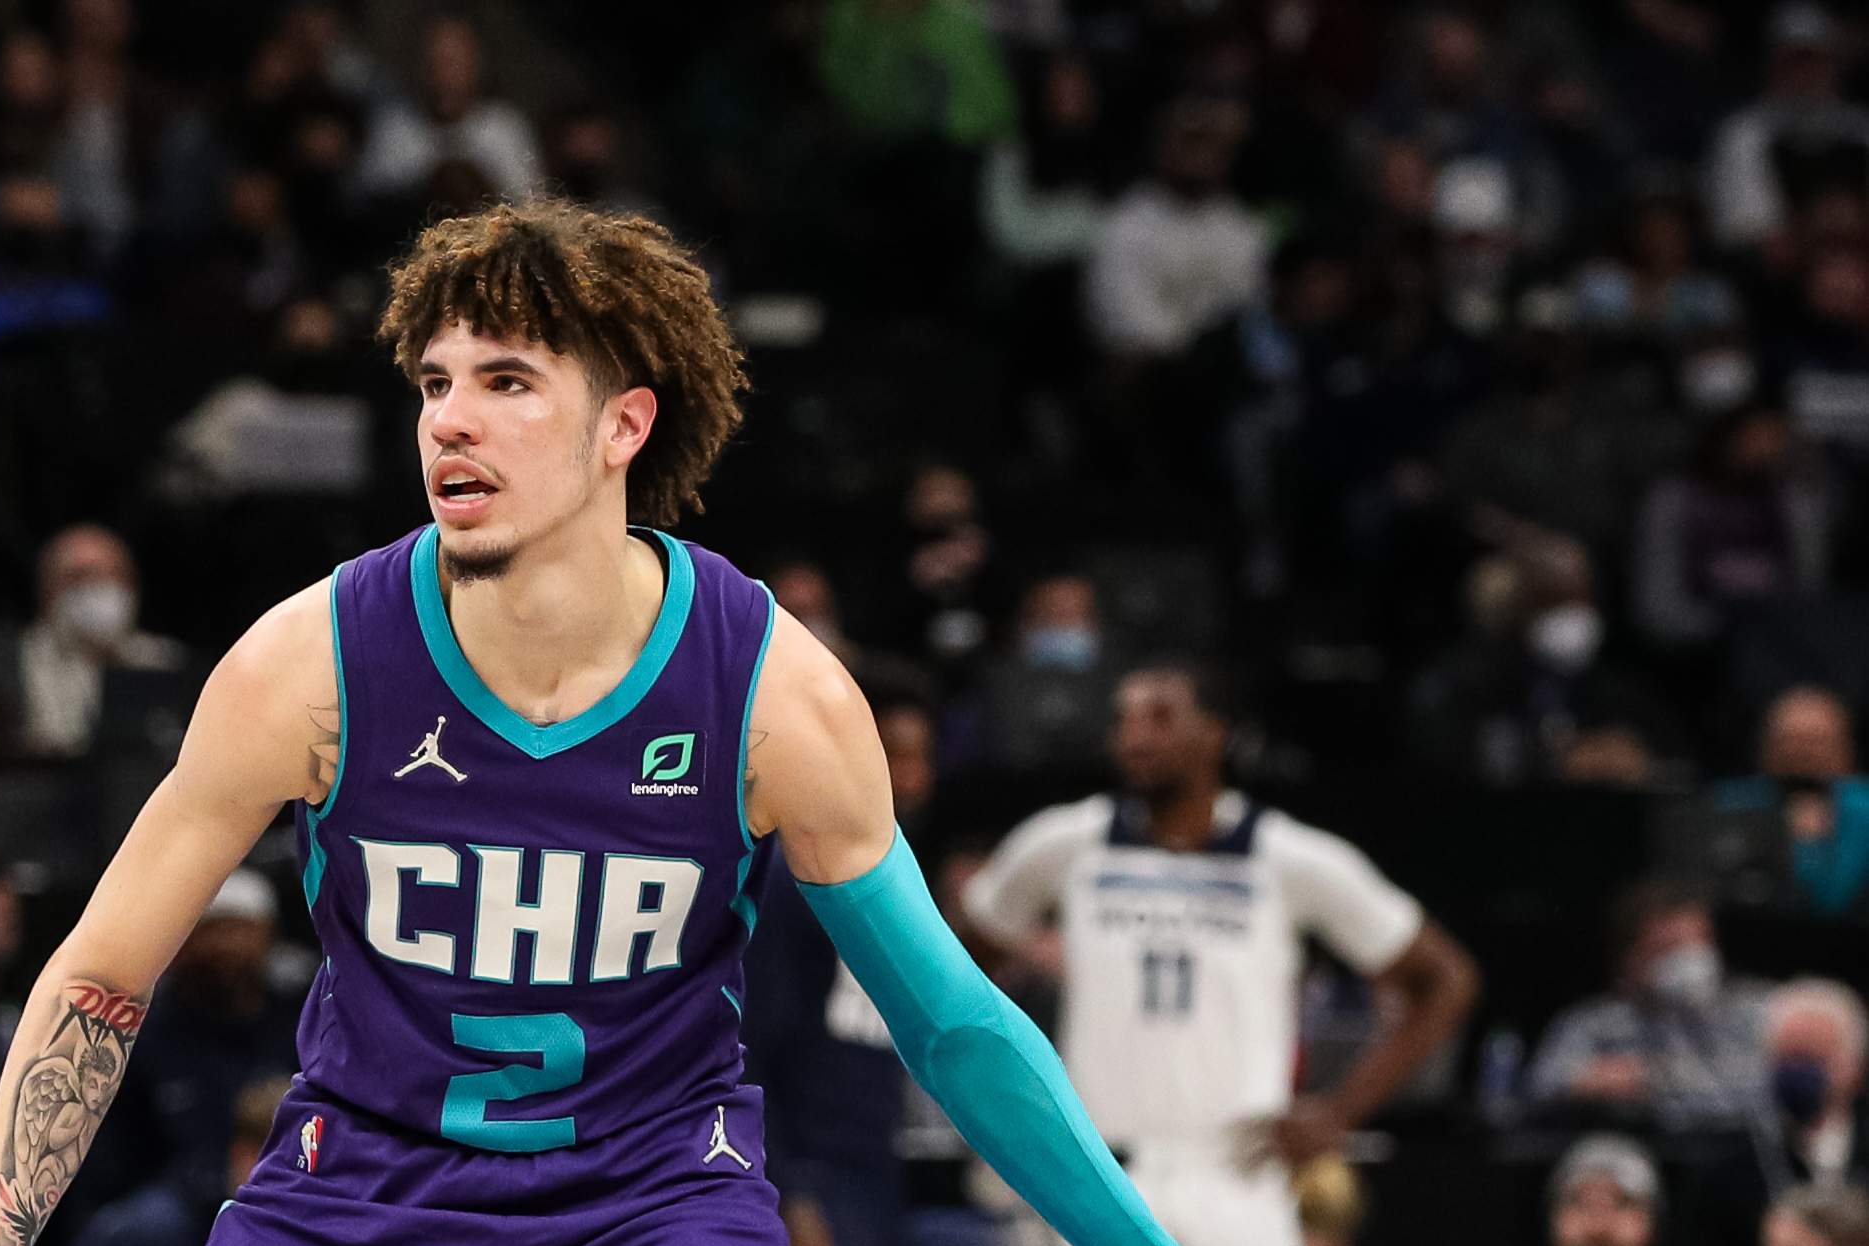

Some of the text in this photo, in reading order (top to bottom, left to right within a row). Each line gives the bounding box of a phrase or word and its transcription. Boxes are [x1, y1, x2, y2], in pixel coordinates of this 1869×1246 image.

[631, 782, 699, 797] lendingtree
[348, 835, 706, 985] CHA
[1140, 948, 1194, 1016] 11
[440, 1012, 586, 1153] 2
